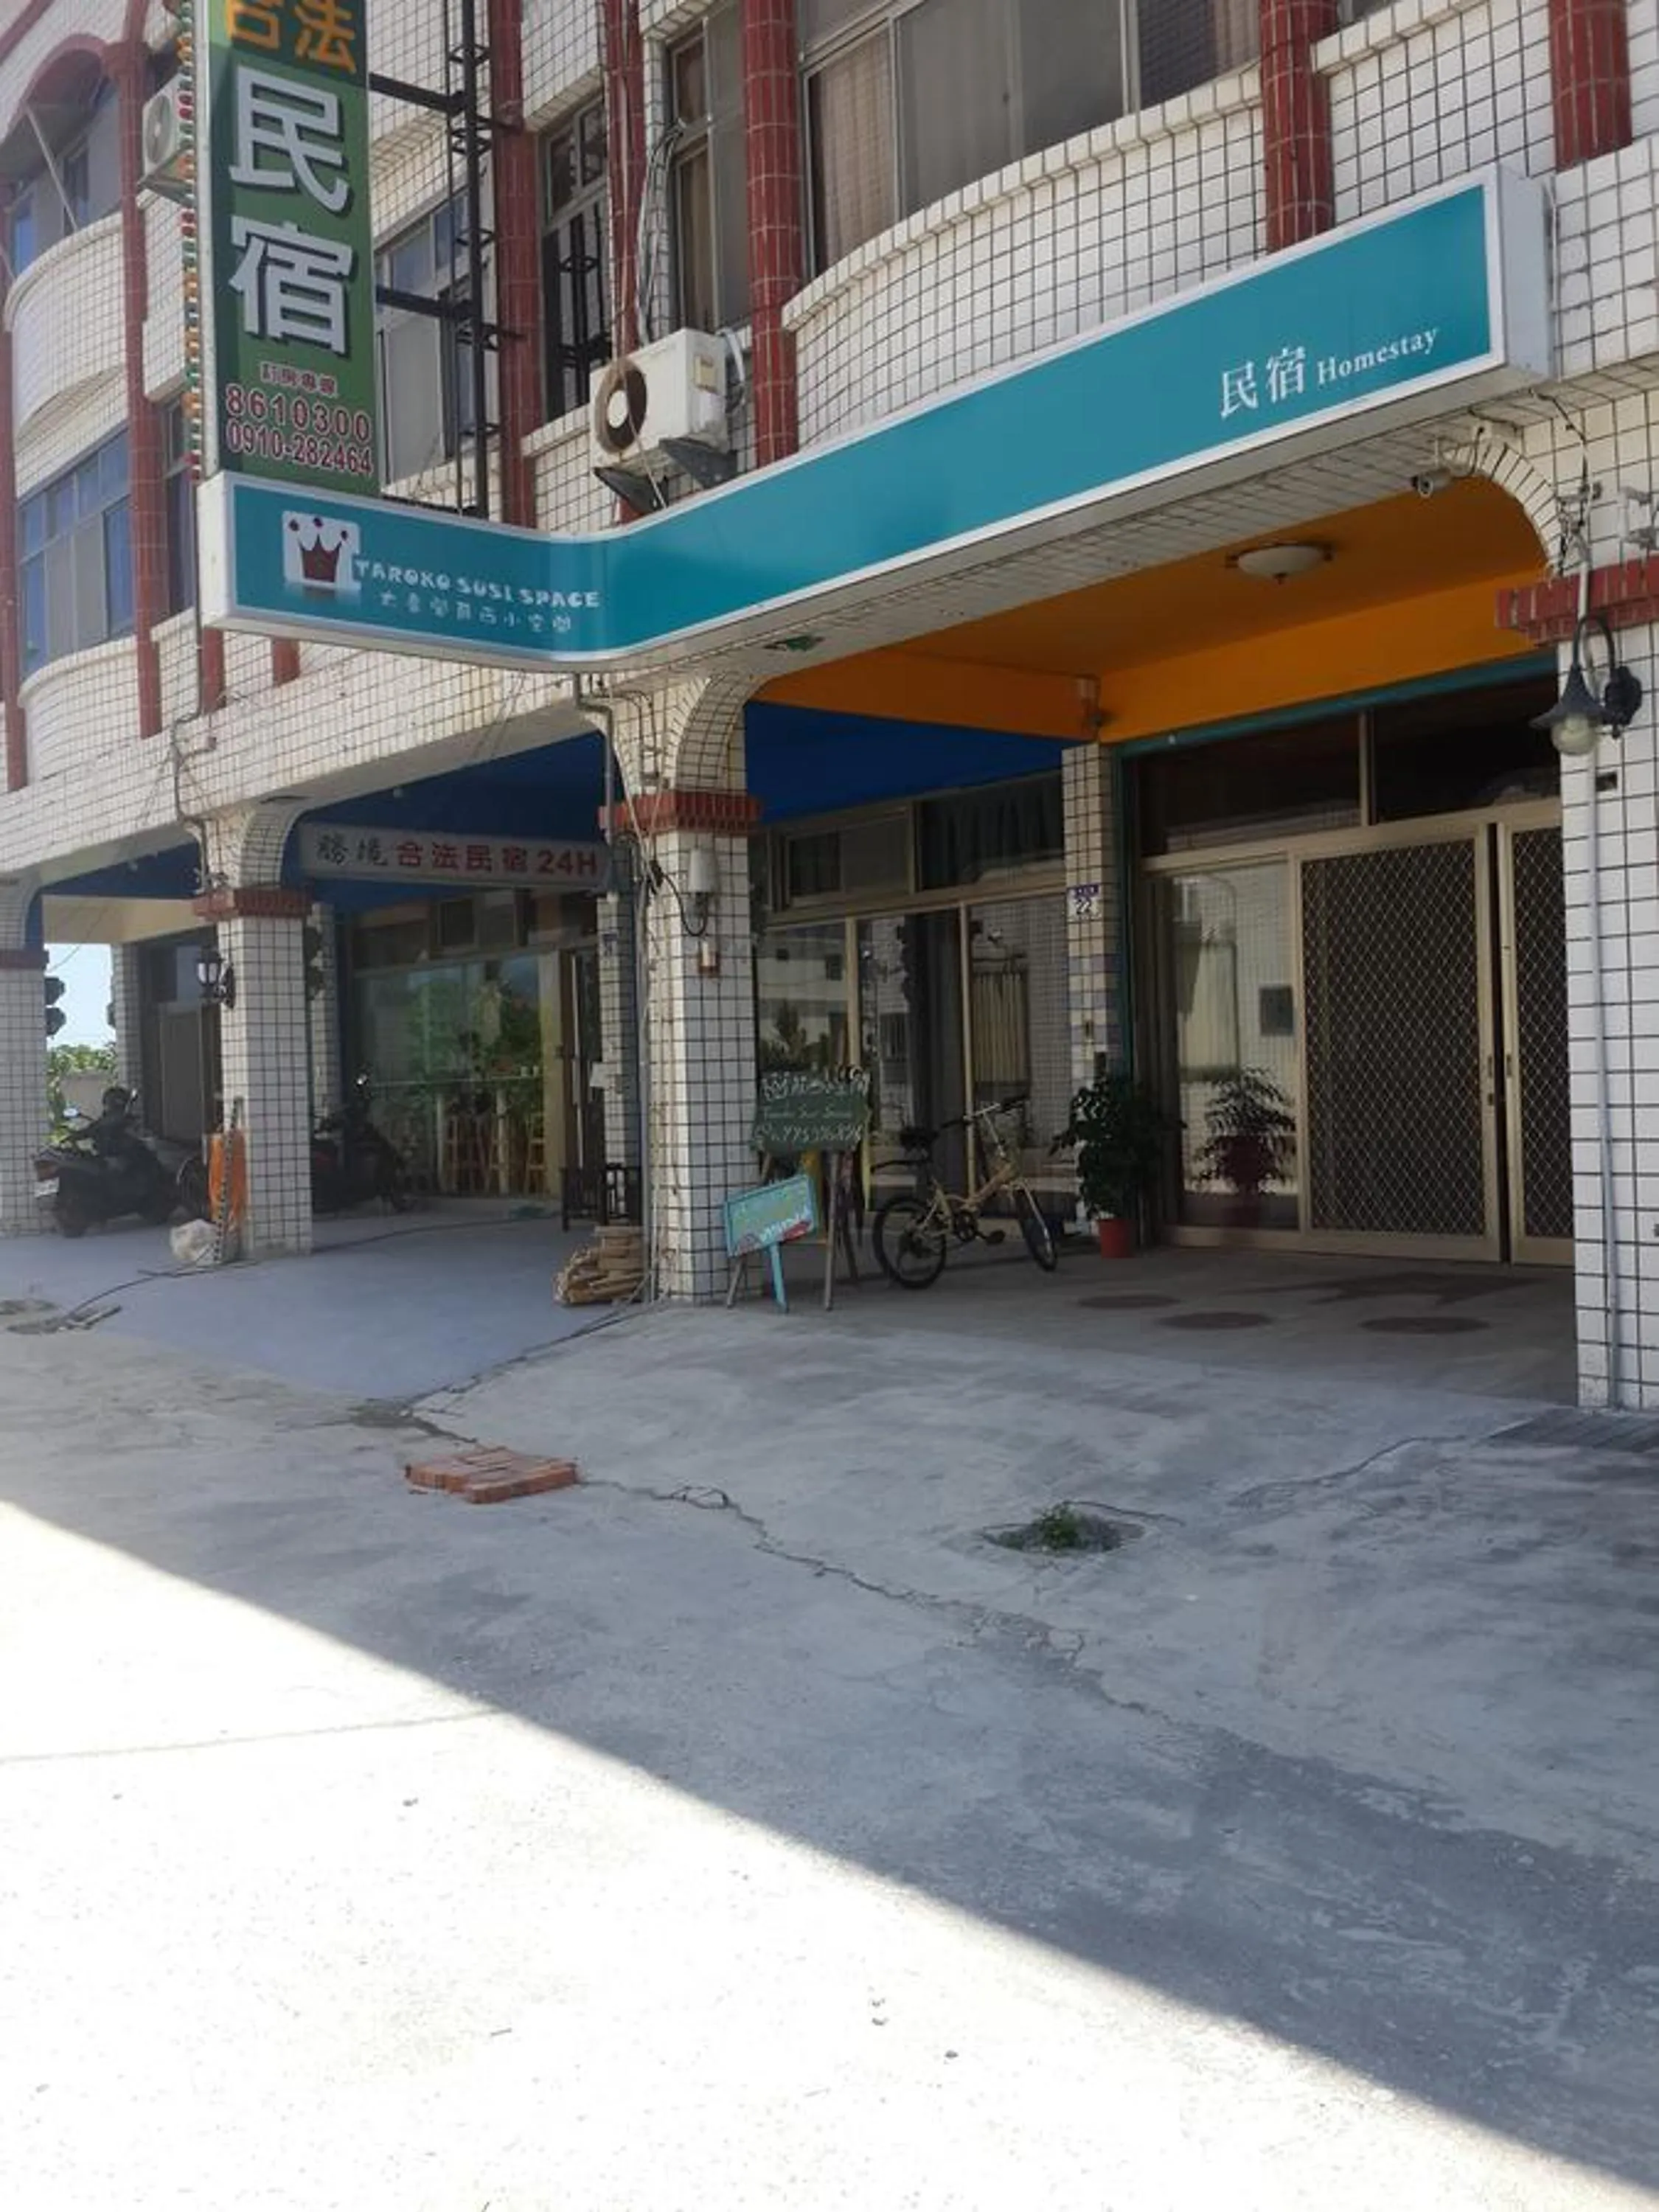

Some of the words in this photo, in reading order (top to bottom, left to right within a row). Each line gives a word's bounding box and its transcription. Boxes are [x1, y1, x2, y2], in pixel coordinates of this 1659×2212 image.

[229, 65, 353, 354] 民宿
[1220, 345, 1307, 420] 民宿
[1316, 327, 1439, 386] Homestay
[226, 383, 372, 445] 8610300
[226, 417, 375, 478] 0910-282464
[355, 559, 451, 591] TAROKO
[456, 577, 514, 602] SUSI
[519, 588, 601, 608] SPACE
